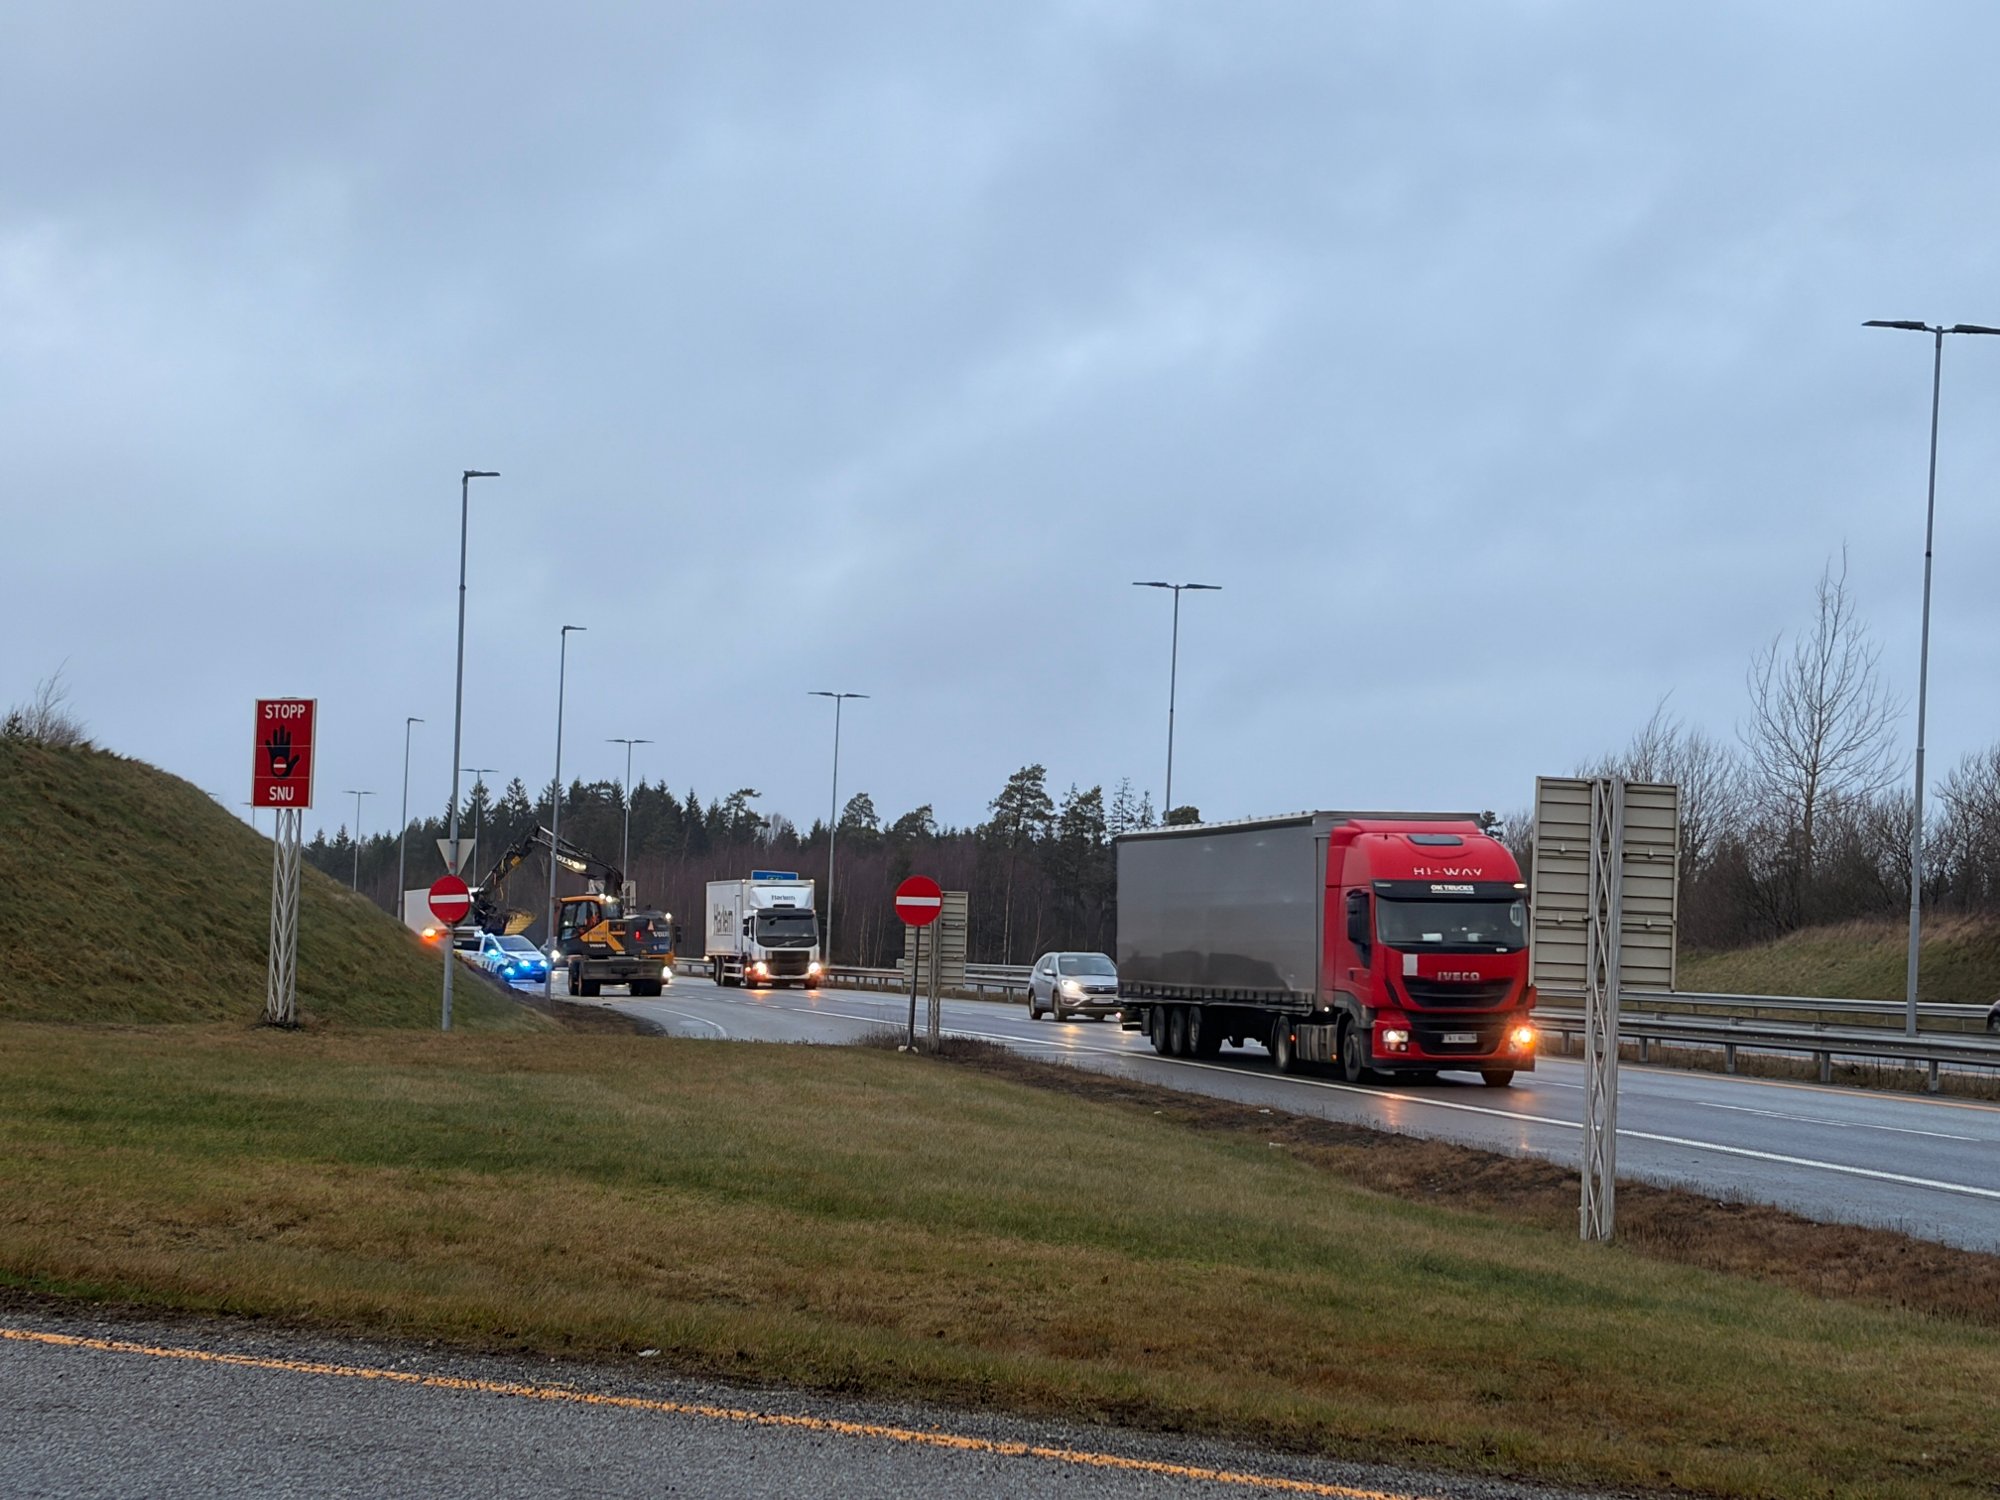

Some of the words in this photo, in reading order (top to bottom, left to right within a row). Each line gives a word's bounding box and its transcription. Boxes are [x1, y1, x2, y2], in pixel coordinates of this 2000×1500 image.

[265, 704, 306, 719] STOPP
[269, 786, 294, 801] SNU
[1413, 867, 1482, 876] HI-WAY
[713, 903, 733, 934] Harlem
[1437, 971, 1480, 981] IVECO
